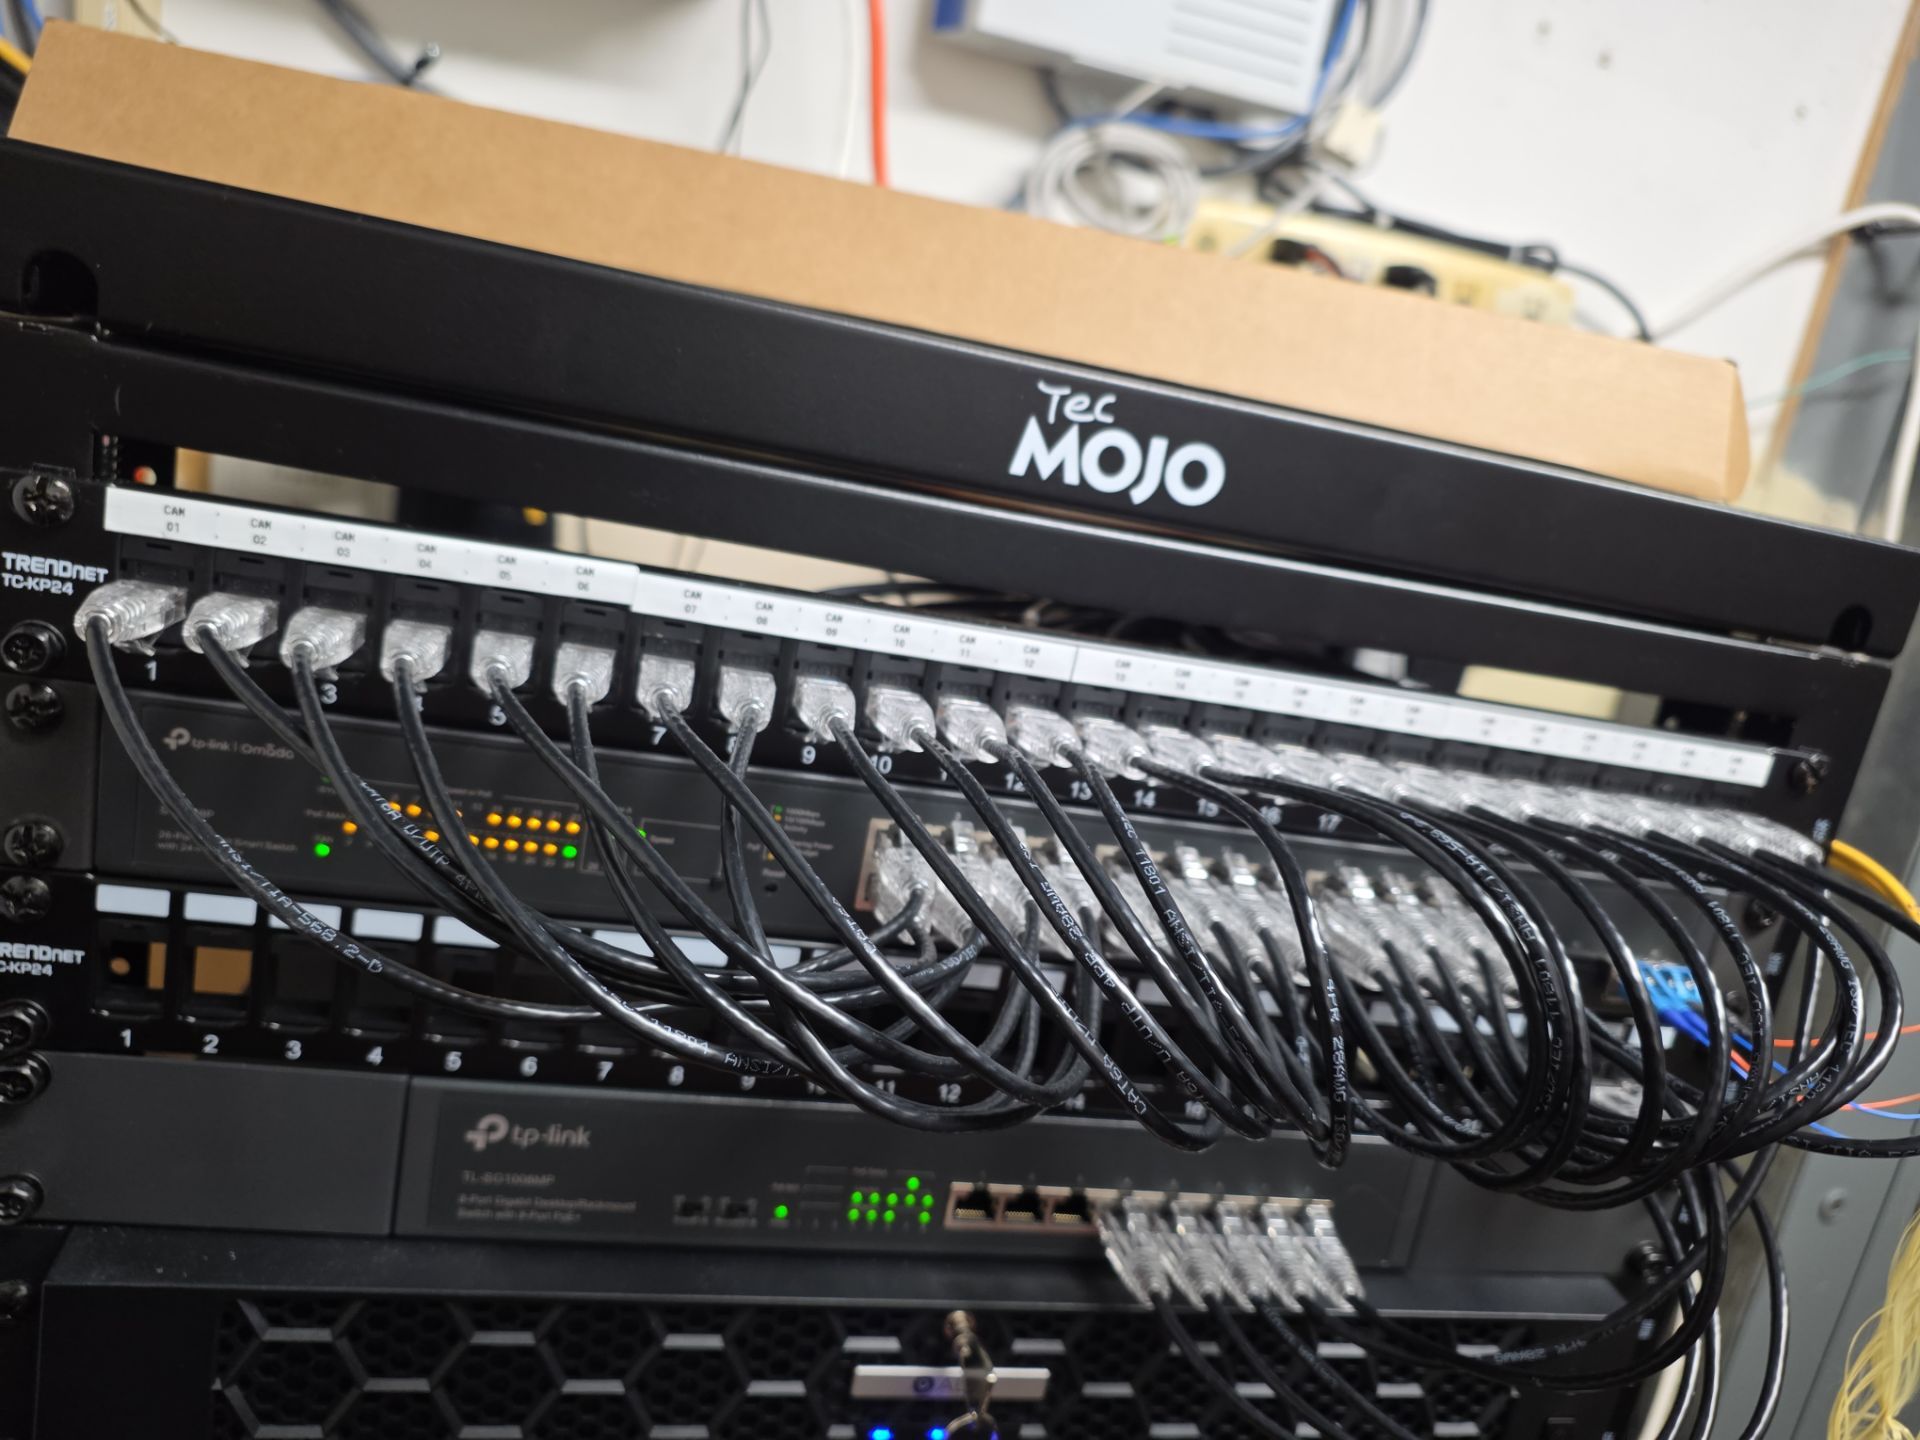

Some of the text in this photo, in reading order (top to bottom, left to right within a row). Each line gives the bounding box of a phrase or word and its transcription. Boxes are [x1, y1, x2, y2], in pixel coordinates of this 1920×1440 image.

[1037, 380, 1117, 424] Tec
[1008, 414, 1226, 506] MOJO
[164, 505, 186, 518] CAM
[166, 521, 180, 533] 01
[250, 518, 272, 530] CAM
[252, 533, 267, 546] 02
[334, 531, 356, 543] CAM
[336, 546, 351, 559] 03
[2, 573, 74, 596] TC-KP24
[147, 661, 158, 681] 1
[321, 684, 338, 705] 3
[489, 706, 506, 726] 5
[191, 738, 231, 752] tp-link
[651, 726, 667, 745] 7
[802, 746, 816, 765] 9
[871, 755, 893, 774] 10
[1070, 781, 1093, 800] 13
[1134, 790, 1156, 807] 14
[1197, 798, 1220, 817] 15
[1318, 813, 1343, 833] 17
[403, 822, 451, 866] U/UTP
[1136, 848, 1166, 896] 11801
[1040, 880, 1085, 941] 28AWG
[1708, 900, 1740, 940] 11801
[0, 960, 53, 977] C-KP24
[1085, 951, 1116, 988] 4PR
[1535, 958, 1560, 1017] 11801
[120, 1028, 132, 1047] 1
[1121, 1001, 1172, 1064] U/UTP
[203, 1033, 219, 1054] 2
[285, 1040, 302, 1060] 3
[366, 1046, 384, 1066] 4
[444, 1051, 462, 1072] 5
[520, 1056, 538, 1077] 6
[598, 1060, 614, 1081] 7
[668, 1065, 685, 1086] 8
[1332, 1036, 1347, 1103] 28AWG
[939, 1083, 962, 1103] 12
[1103, 1053, 1147, 1115] CAT6A
[512, 1122, 591, 1151] tp-link
